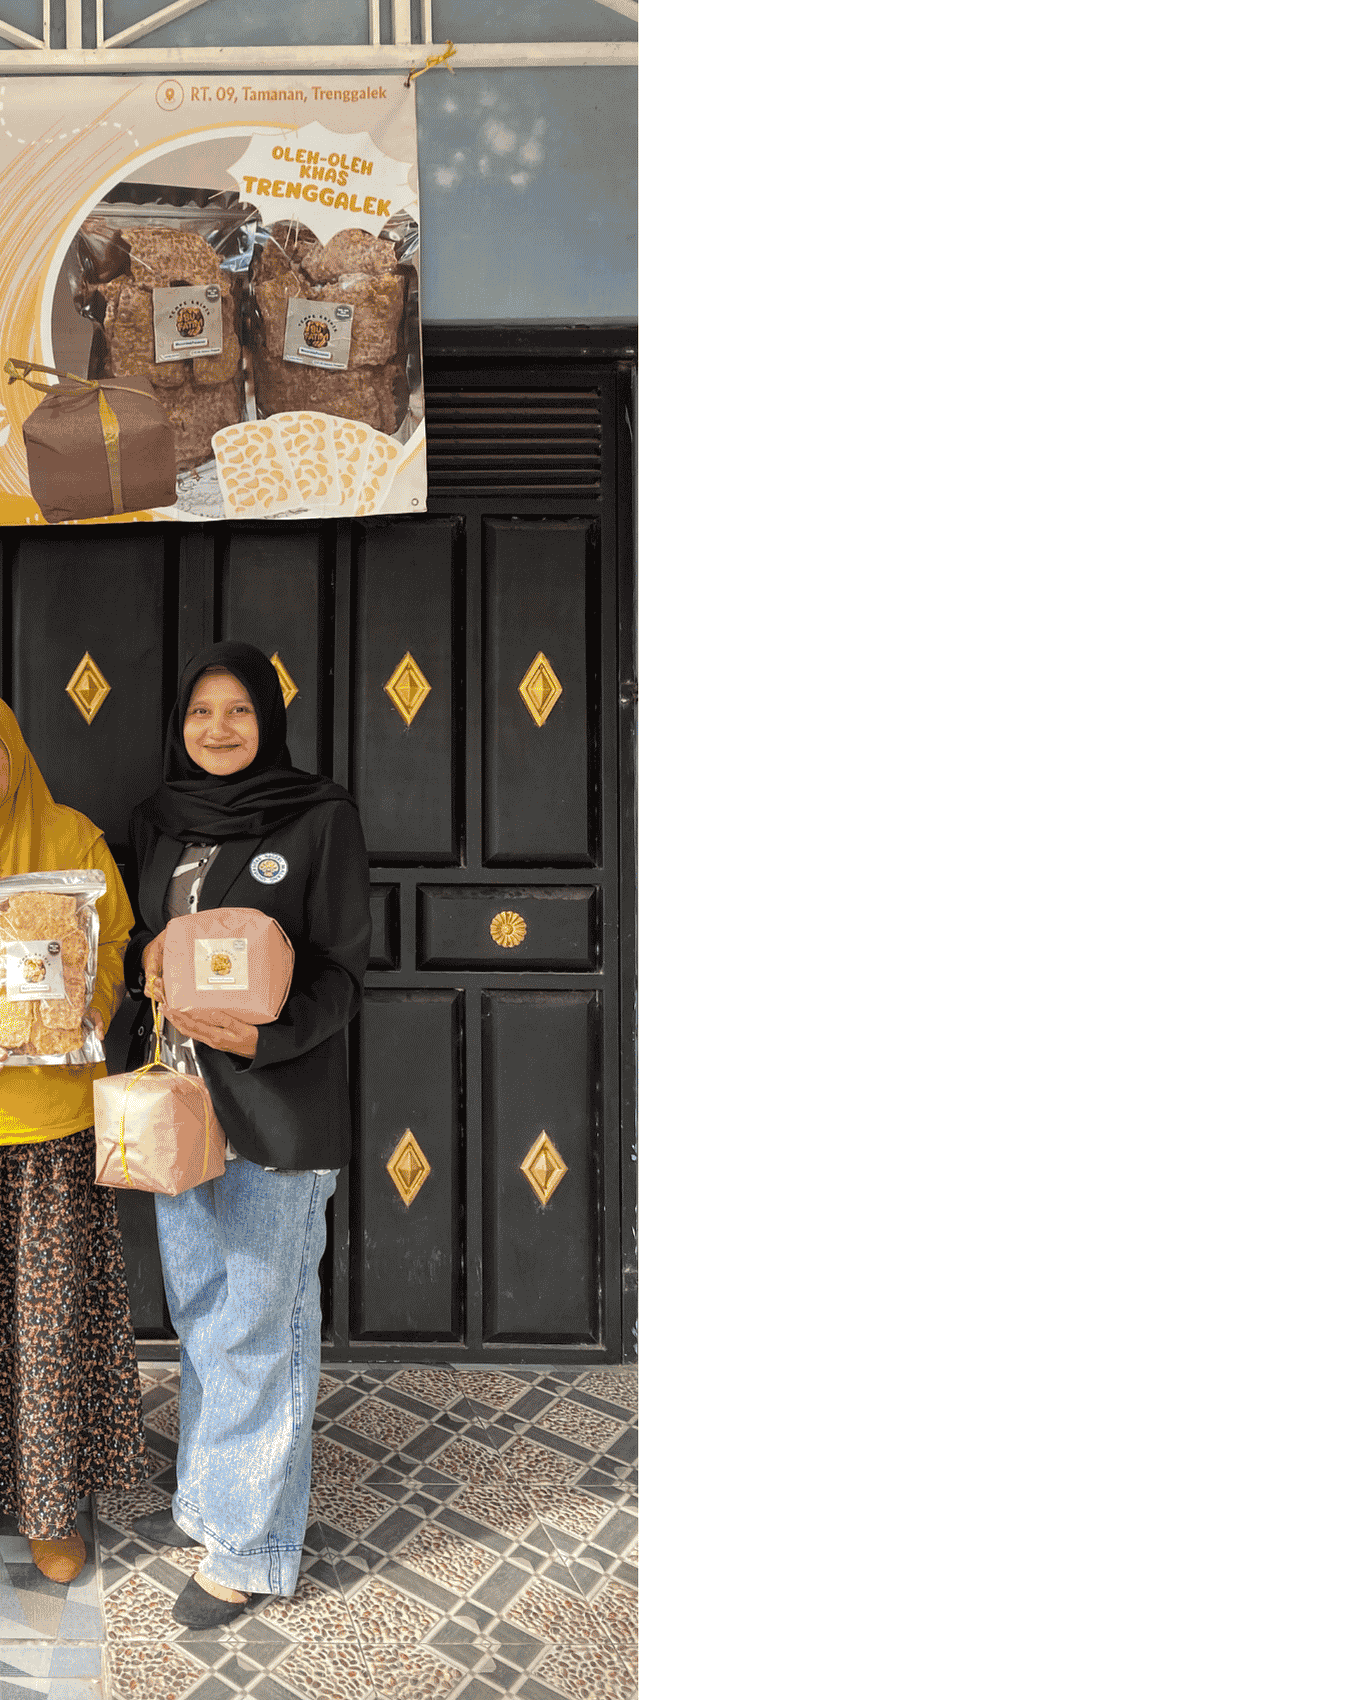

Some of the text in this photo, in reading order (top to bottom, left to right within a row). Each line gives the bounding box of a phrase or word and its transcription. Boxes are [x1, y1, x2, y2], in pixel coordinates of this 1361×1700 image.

[190, 86, 387, 103] RT. 09, Tamanan, Trenggalek
[271, 145, 374, 176] OLEH-OLEH
[299, 164, 349, 187] KHAS
[243, 176, 391, 217] TRENGGALEK
